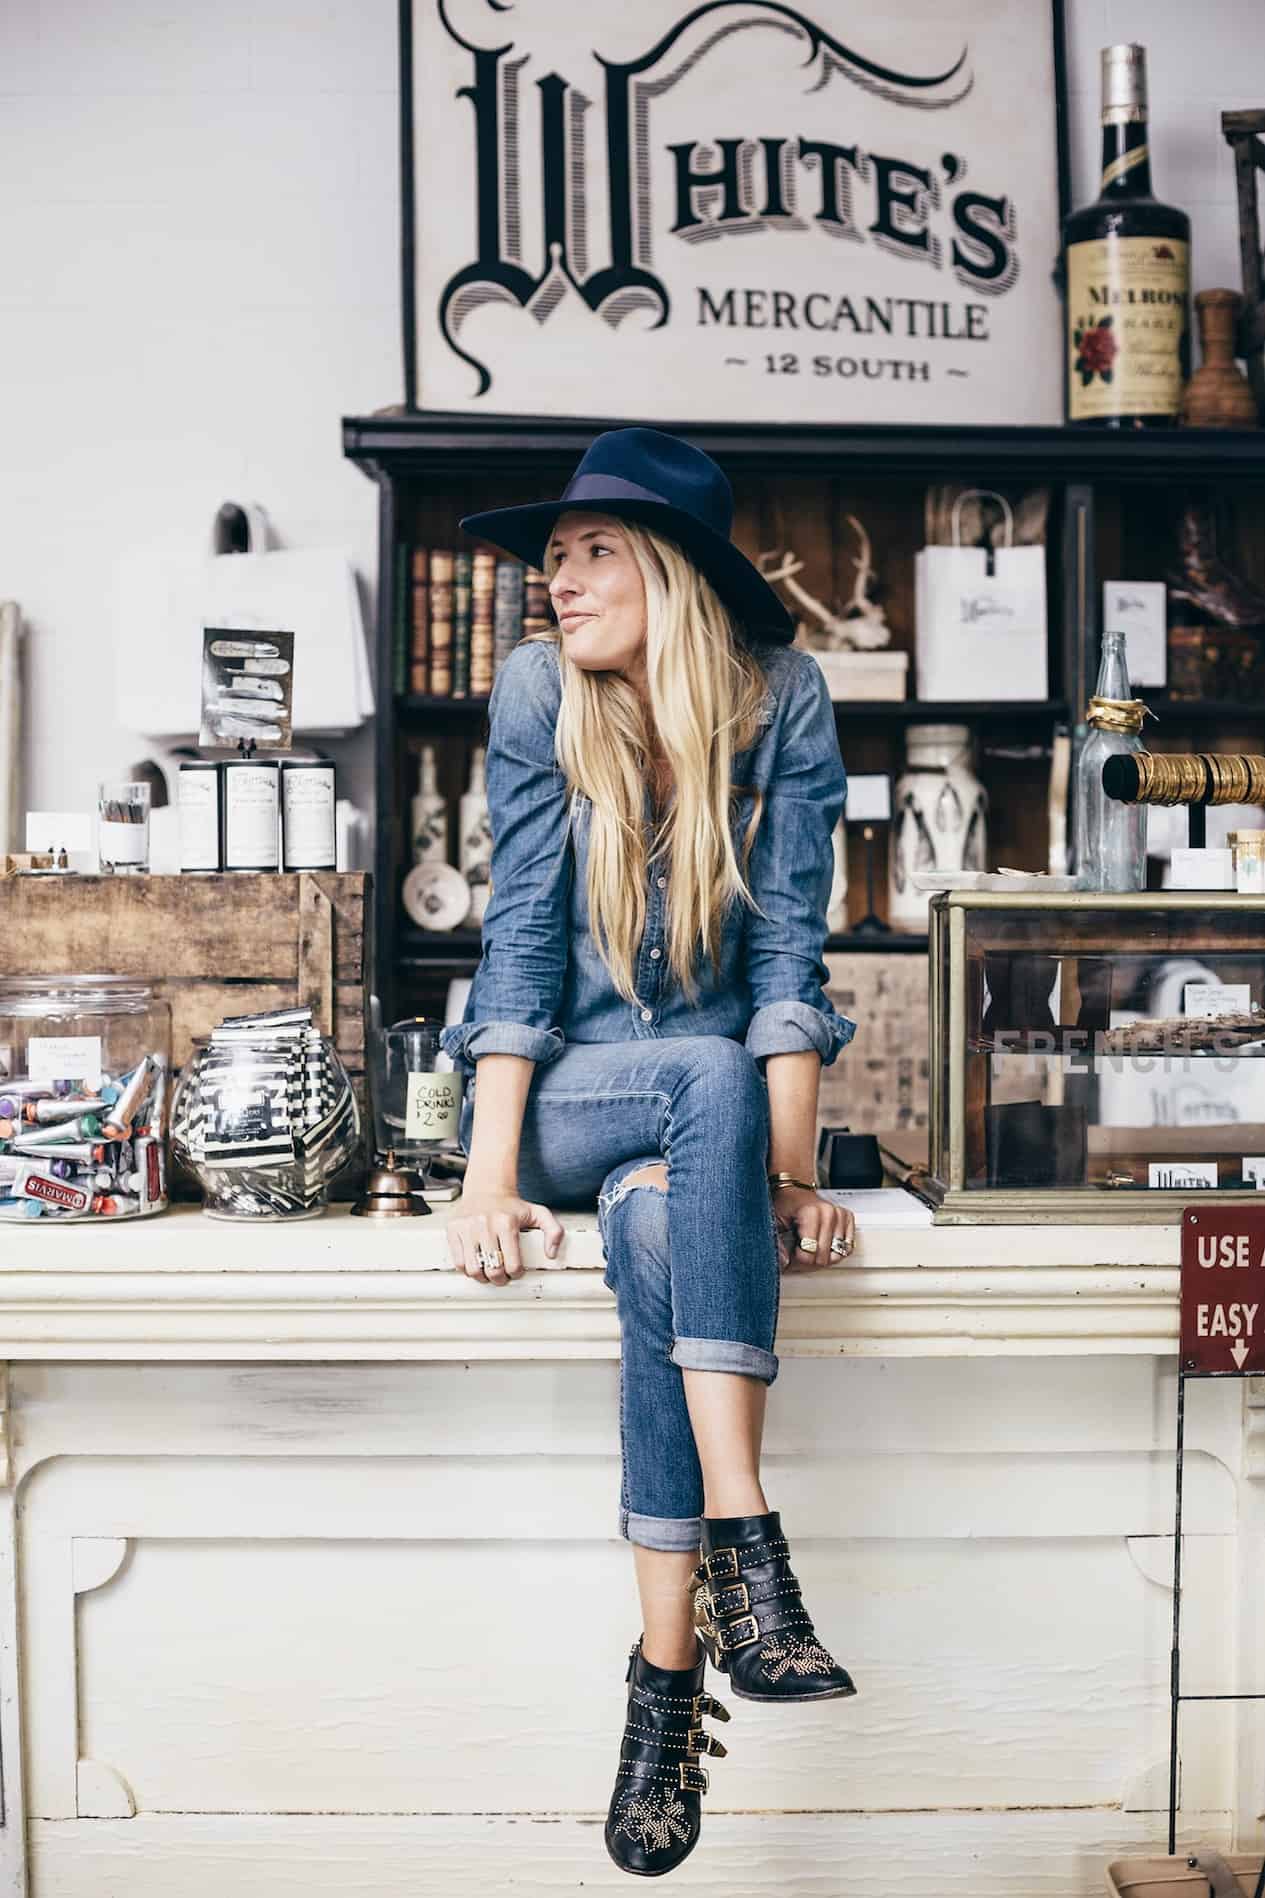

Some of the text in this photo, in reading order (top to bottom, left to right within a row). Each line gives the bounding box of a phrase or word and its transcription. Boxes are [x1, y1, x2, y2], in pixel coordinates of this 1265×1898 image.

[438, 0, 1020, 397] WHITE'S
[696, 287, 990, 341] MERCANTILE
[765, 353, 930, 381] 12 SOUTH
[416, 1097, 455, 1110] DRINKS
[417, 1086, 451, 1098] COLD
[27, 1179, 73, 1203] MARVIS
[1198, 1235, 1250, 1269] USE
[1197, 1303, 1259, 1337] EASY
